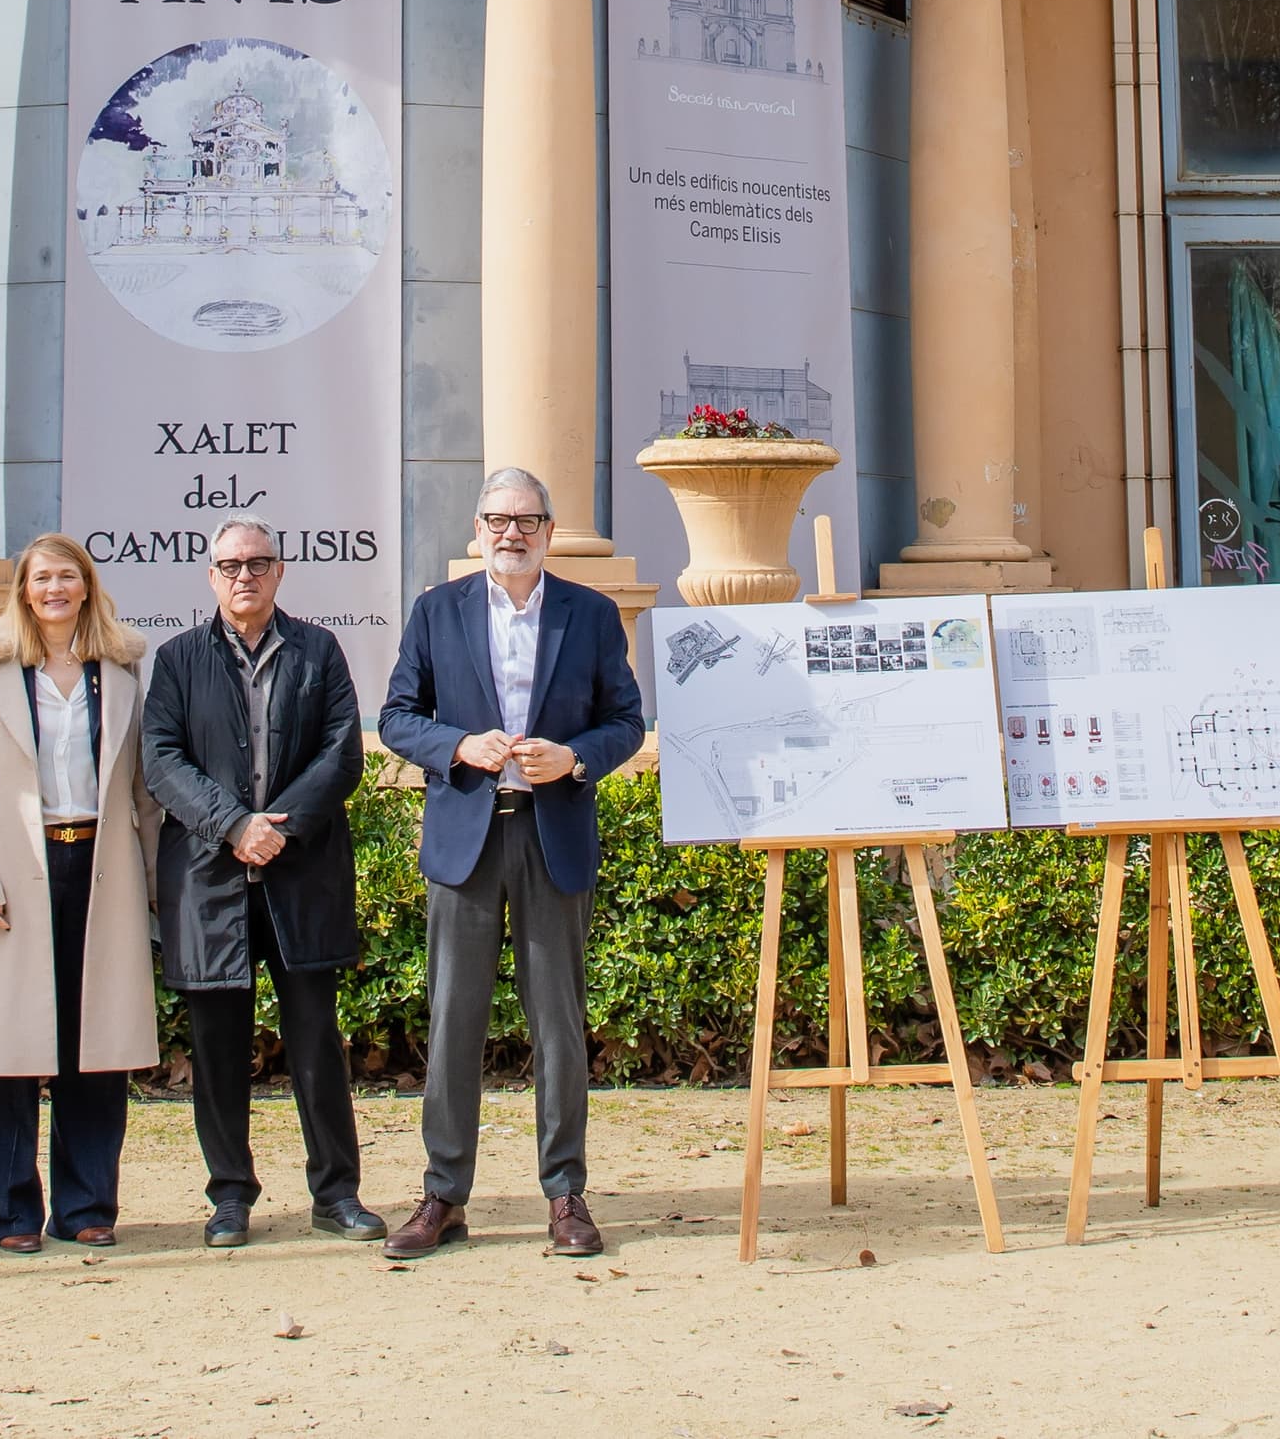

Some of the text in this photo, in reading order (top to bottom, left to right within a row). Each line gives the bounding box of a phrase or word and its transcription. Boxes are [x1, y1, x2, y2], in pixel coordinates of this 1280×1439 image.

[629, 166, 831, 203] Un dels edificis noucentistes
[654, 194, 814, 224] més emblemàtics dels
[690, 220, 782, 245] Camps Elisis
[153, 422, 298, 455] XALET
[183, 473, 267, 509] dels
[84, 530, 378, 563] CAMP LISIS
